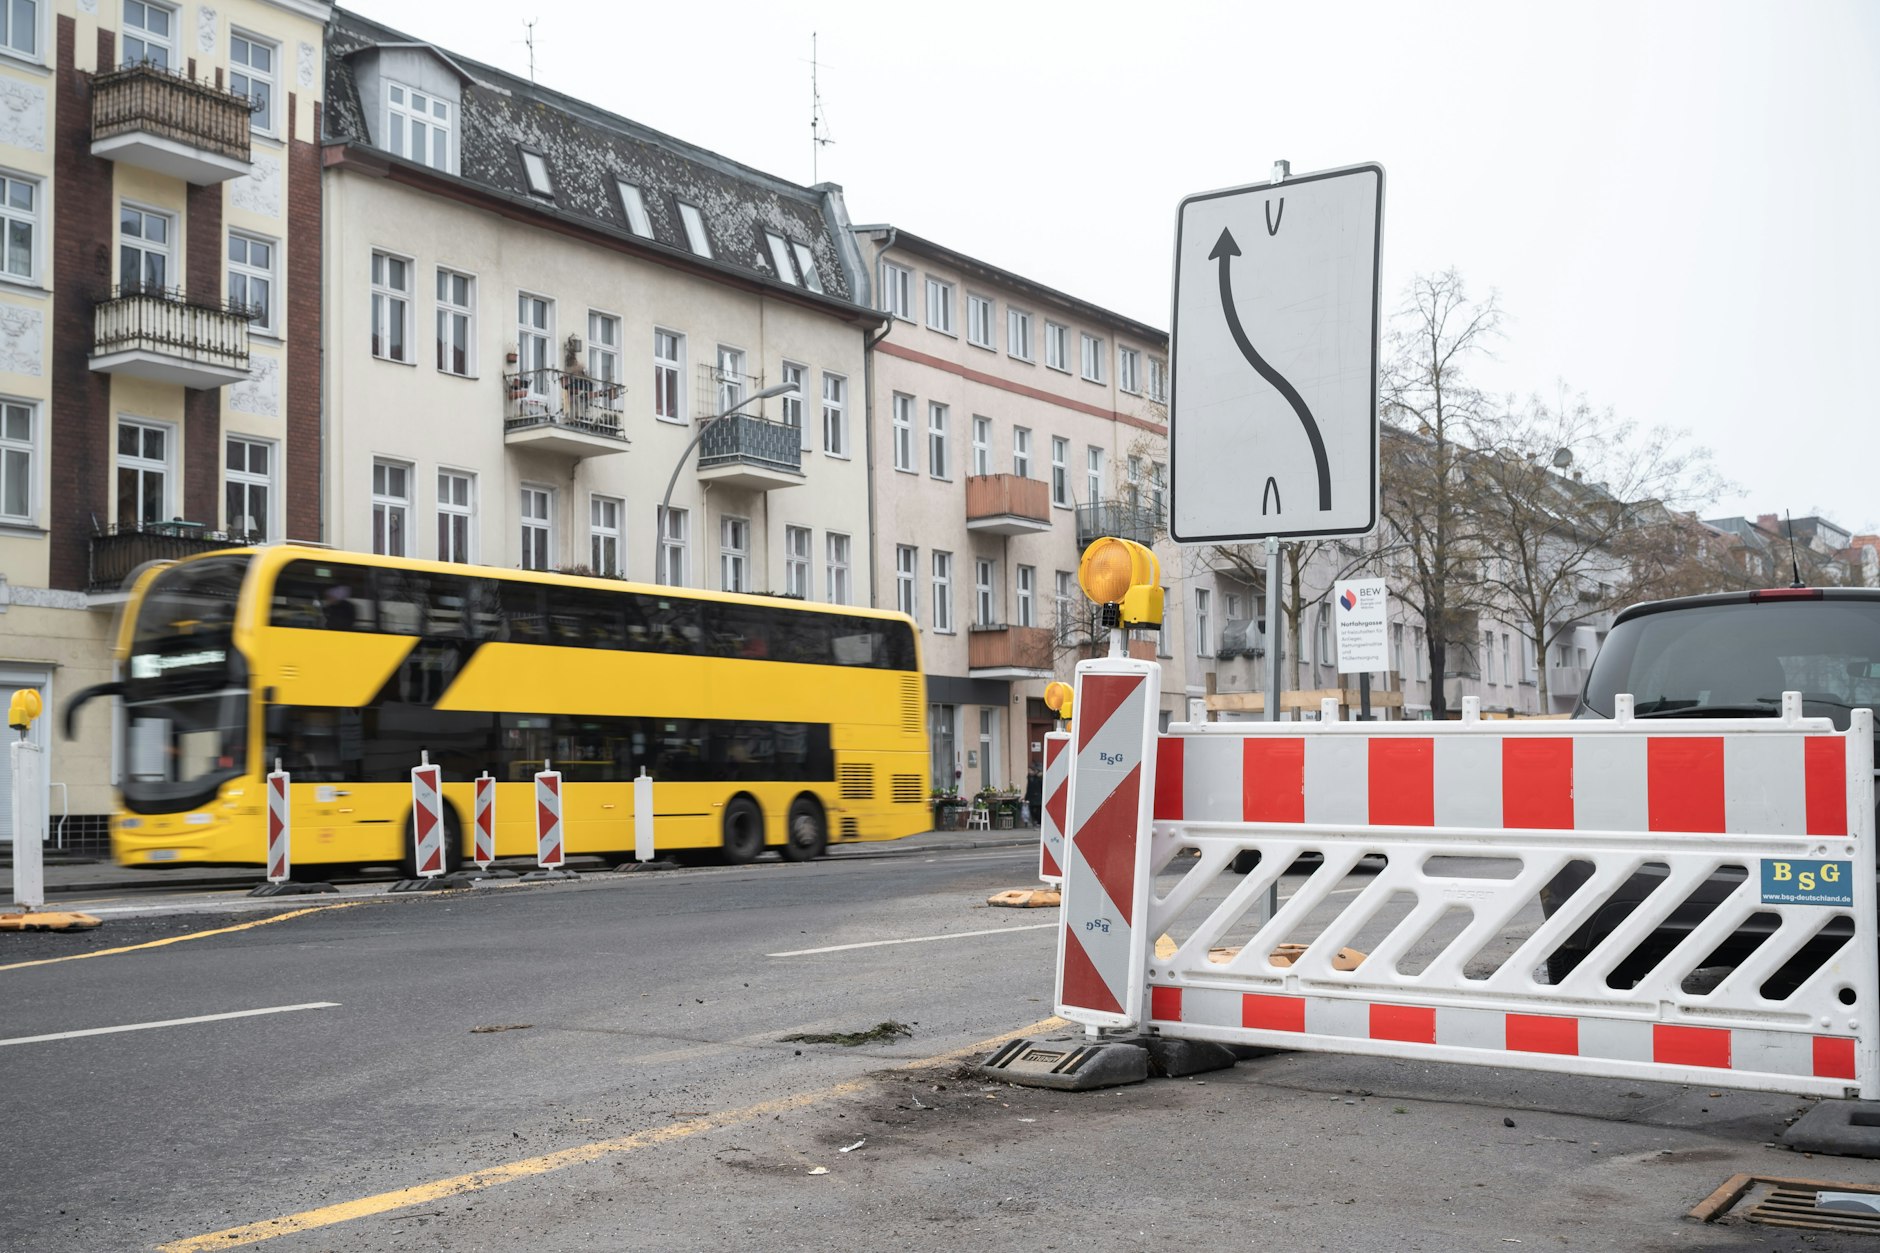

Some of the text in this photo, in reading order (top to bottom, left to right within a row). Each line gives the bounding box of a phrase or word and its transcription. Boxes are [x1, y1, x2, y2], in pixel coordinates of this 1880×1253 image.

[1360, 588, 1381, 596] BEW
[1100, 752, 1123, 765] BSG
[1773, 862, 1840, 891] BSG
[1763, 893, 1851, 903] www.bsg-deutschland.de
[1086, 919, 1109, 933] BSG
